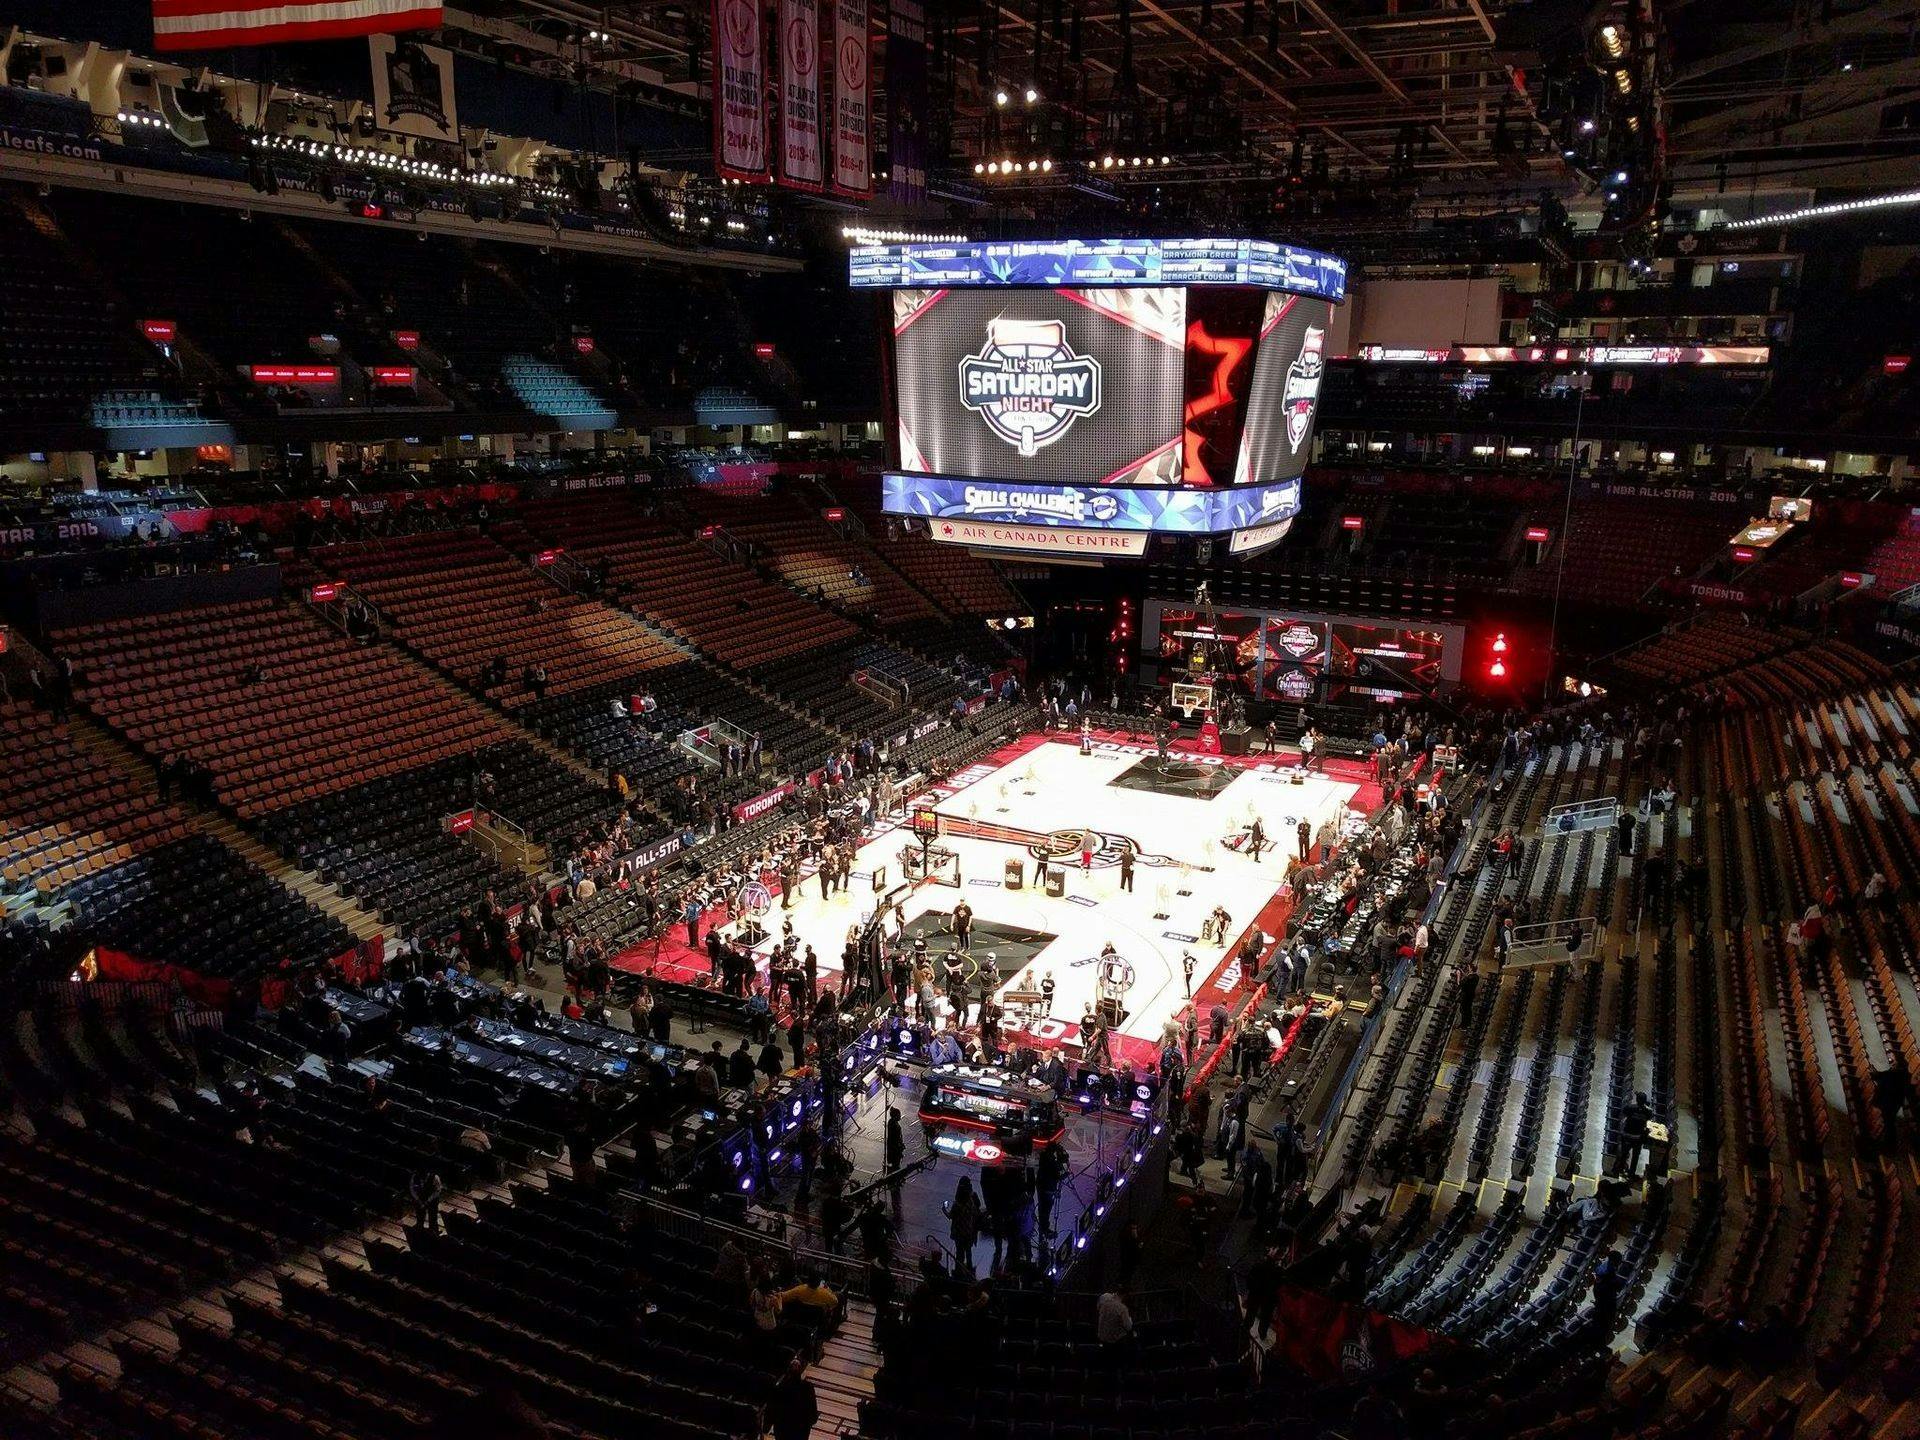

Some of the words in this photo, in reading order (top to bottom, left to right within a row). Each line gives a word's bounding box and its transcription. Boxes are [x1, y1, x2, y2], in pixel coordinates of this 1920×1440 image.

[0, 130, 101, 160] leafs.com
[1163, 250, 1208, 259] DRAYMOND
[1209, 250, 1236, 259] GREEN
[1162, 273, 1202, 282] DEMARCUS
[1203, 273, 1235, 281] COUSINS
[968, 371, 1089, 397] SATURDAY
[1002, 396, 1053, 412] NIGHT
[964, 486, 1007, 513] SKILLS
[1009, 490, 1085, 521] CHALLENGE
[58, 522, 98, 539] 2016
[962, 526, 987, 539] AIR
[993, 528, 1059, 545] CANADA
[1065, 534, 1131, 548] CENTRE
[1690, 583, 1744, 601] TORONTO
[1193, 631, 1221, 641] SATURDY
[635, 838, 680, 869] ALL-STA
[933, 1138, 961, 1153] NBA
[977, 1150, 999, 1160] TNT
